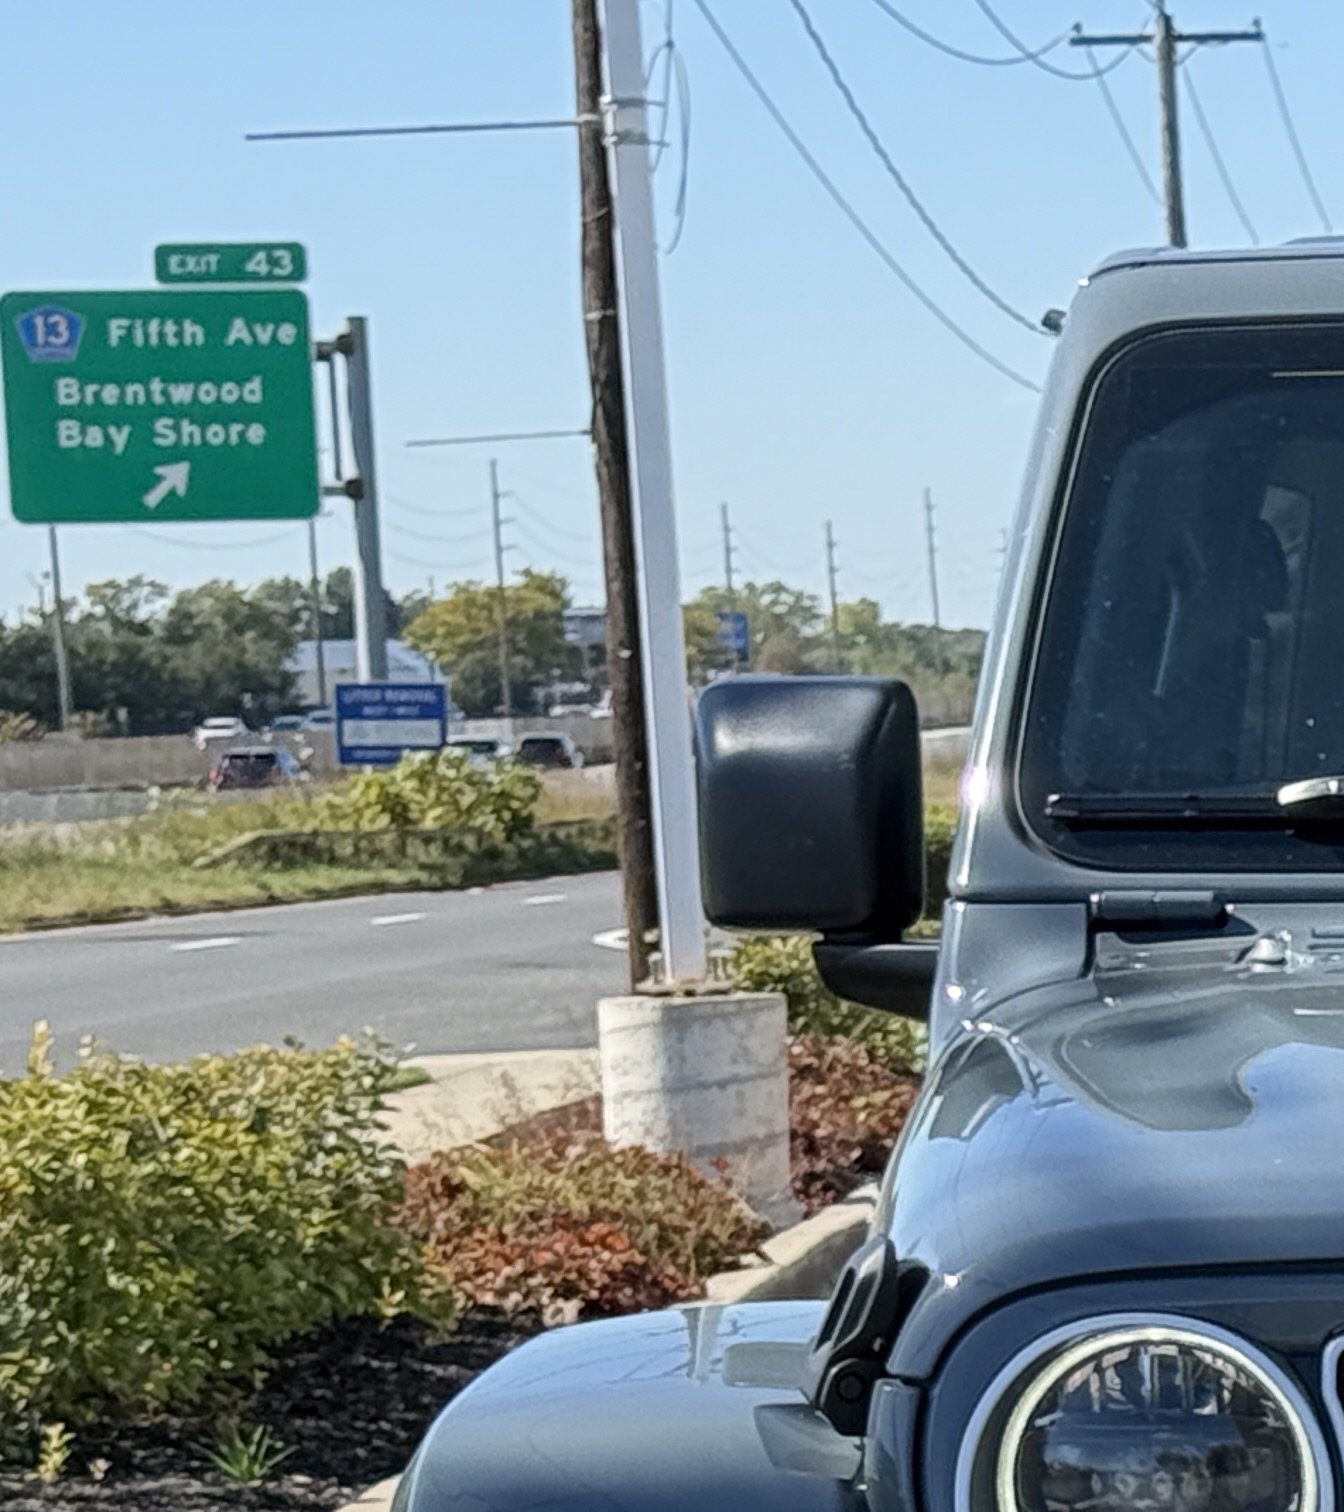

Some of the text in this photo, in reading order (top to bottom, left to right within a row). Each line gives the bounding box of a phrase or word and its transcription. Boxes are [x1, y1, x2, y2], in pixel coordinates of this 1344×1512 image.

[168, 249, 293, 277] EXIT 43
[34, 314, 69, 346] 13
[107, 316, 298, 347] Fifth Ave
[55, 376, 263, 407] Brentwood
[55, 416, 266, 454] Bay Shore
